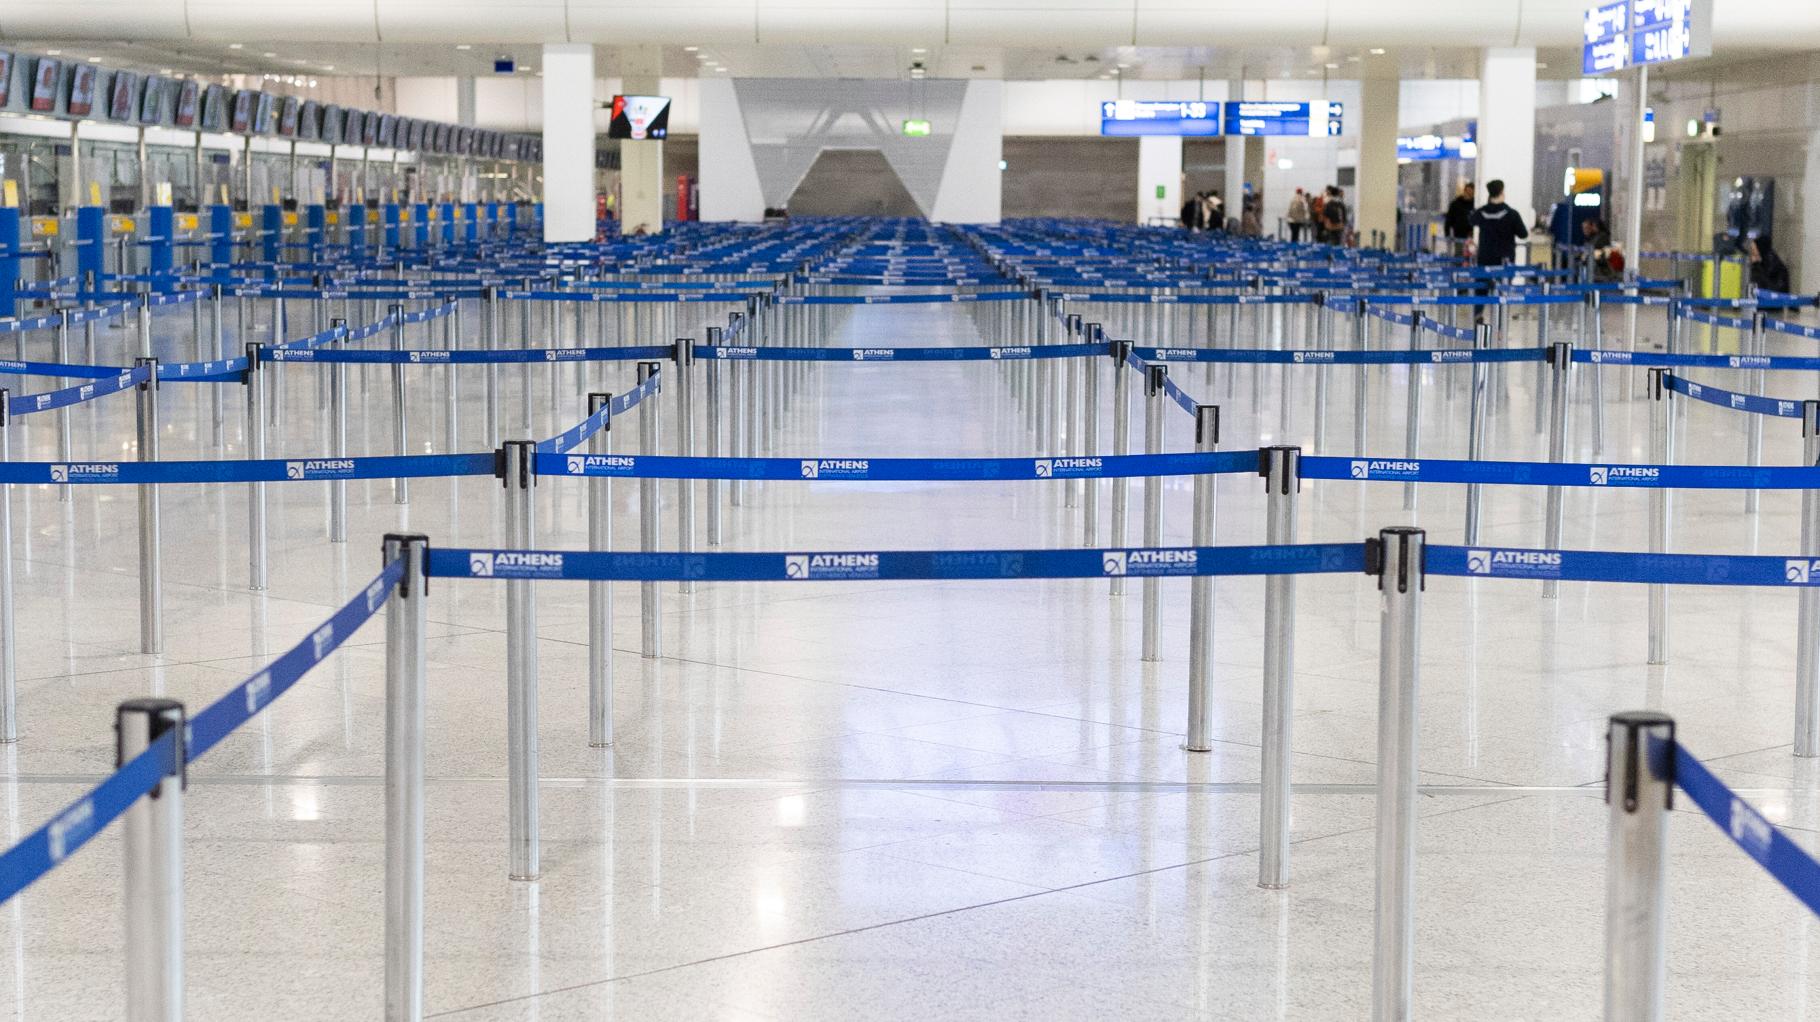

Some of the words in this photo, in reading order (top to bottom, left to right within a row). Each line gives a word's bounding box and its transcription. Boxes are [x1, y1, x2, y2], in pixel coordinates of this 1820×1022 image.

[306, 461, 354, 469] ATHENS
[586, 457, 634, 466] ATHENS
[820, 460, 868, 469] ATHENS
[1054, 459, 1102, 467] ATHENS
[1370, 461, 1420, 470] ATHENS
[70, 465, 118, 473] ATHENS
[1609, 468, 1659, 476] ATHENS
[495, 553, 563, 565] ATHENS
[811, 555, 879, 566] ATHENS
[1129, 551, 1197, 563] ATHENS
[1494, 551, 1562, 564] ATHENS
